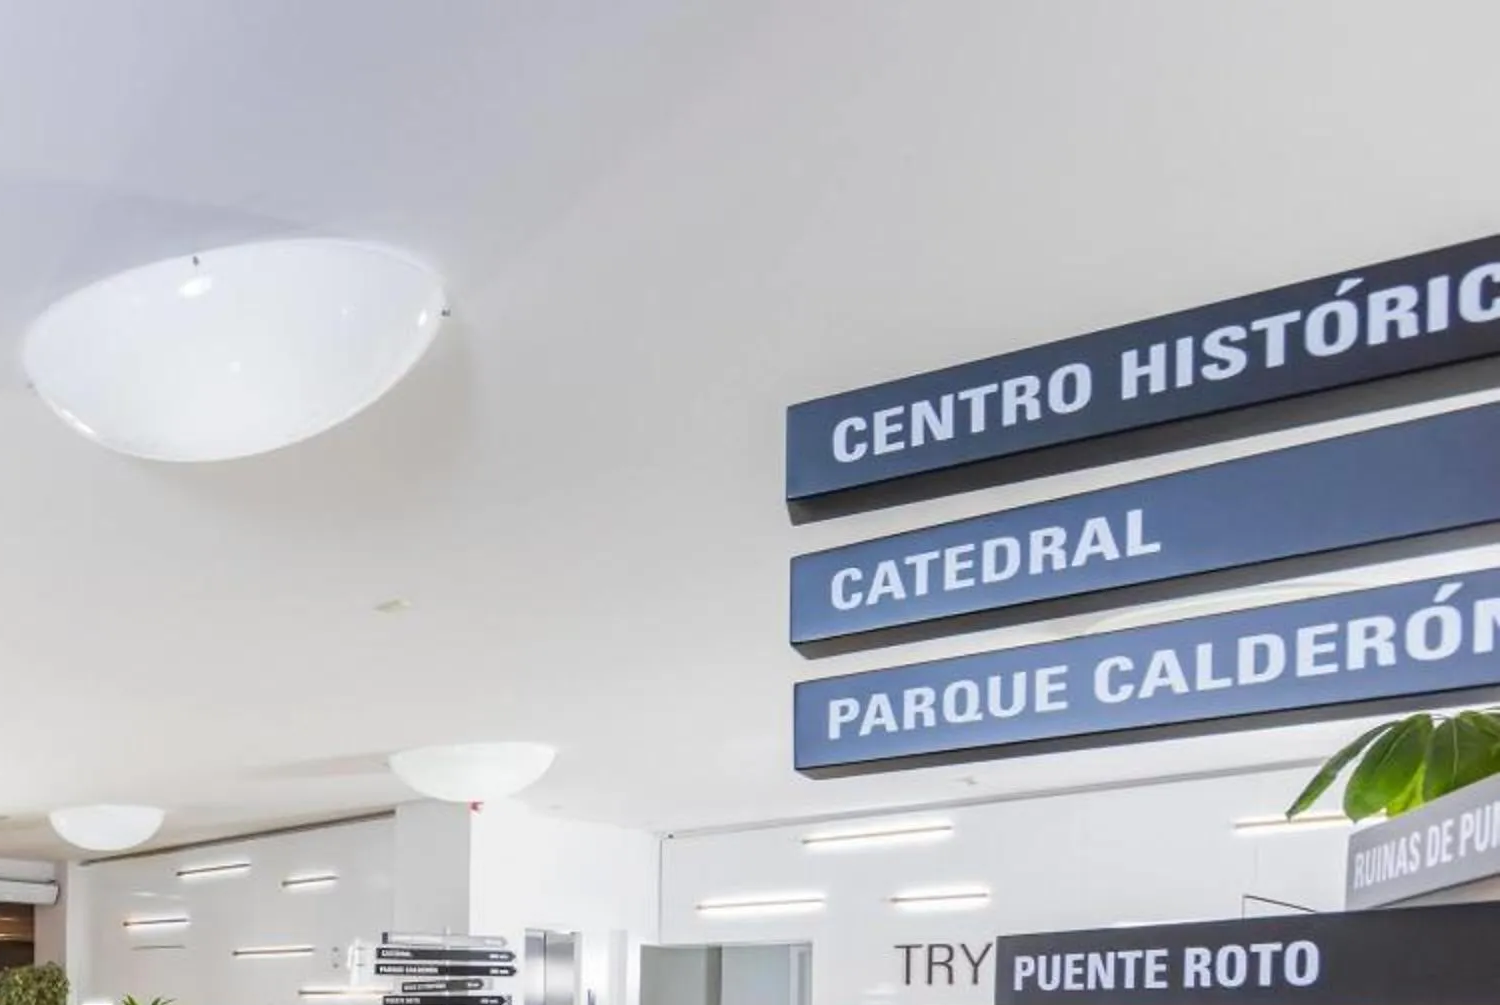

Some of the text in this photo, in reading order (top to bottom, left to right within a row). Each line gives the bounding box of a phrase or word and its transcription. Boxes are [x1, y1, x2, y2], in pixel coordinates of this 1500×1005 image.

[831, 262, 1500, 462] CENTRO HISTÓRIC
[830, 509, 1162, 611] CATEDRAL
[827, 583, 1500, 740] PARQUE CALDERÓN
[1353, 800, 1500, 889] RUINAS DE PU
[893, 941, 994, 986] TRY
[1013, 940, 1321, 991] PUENTE ROTO
